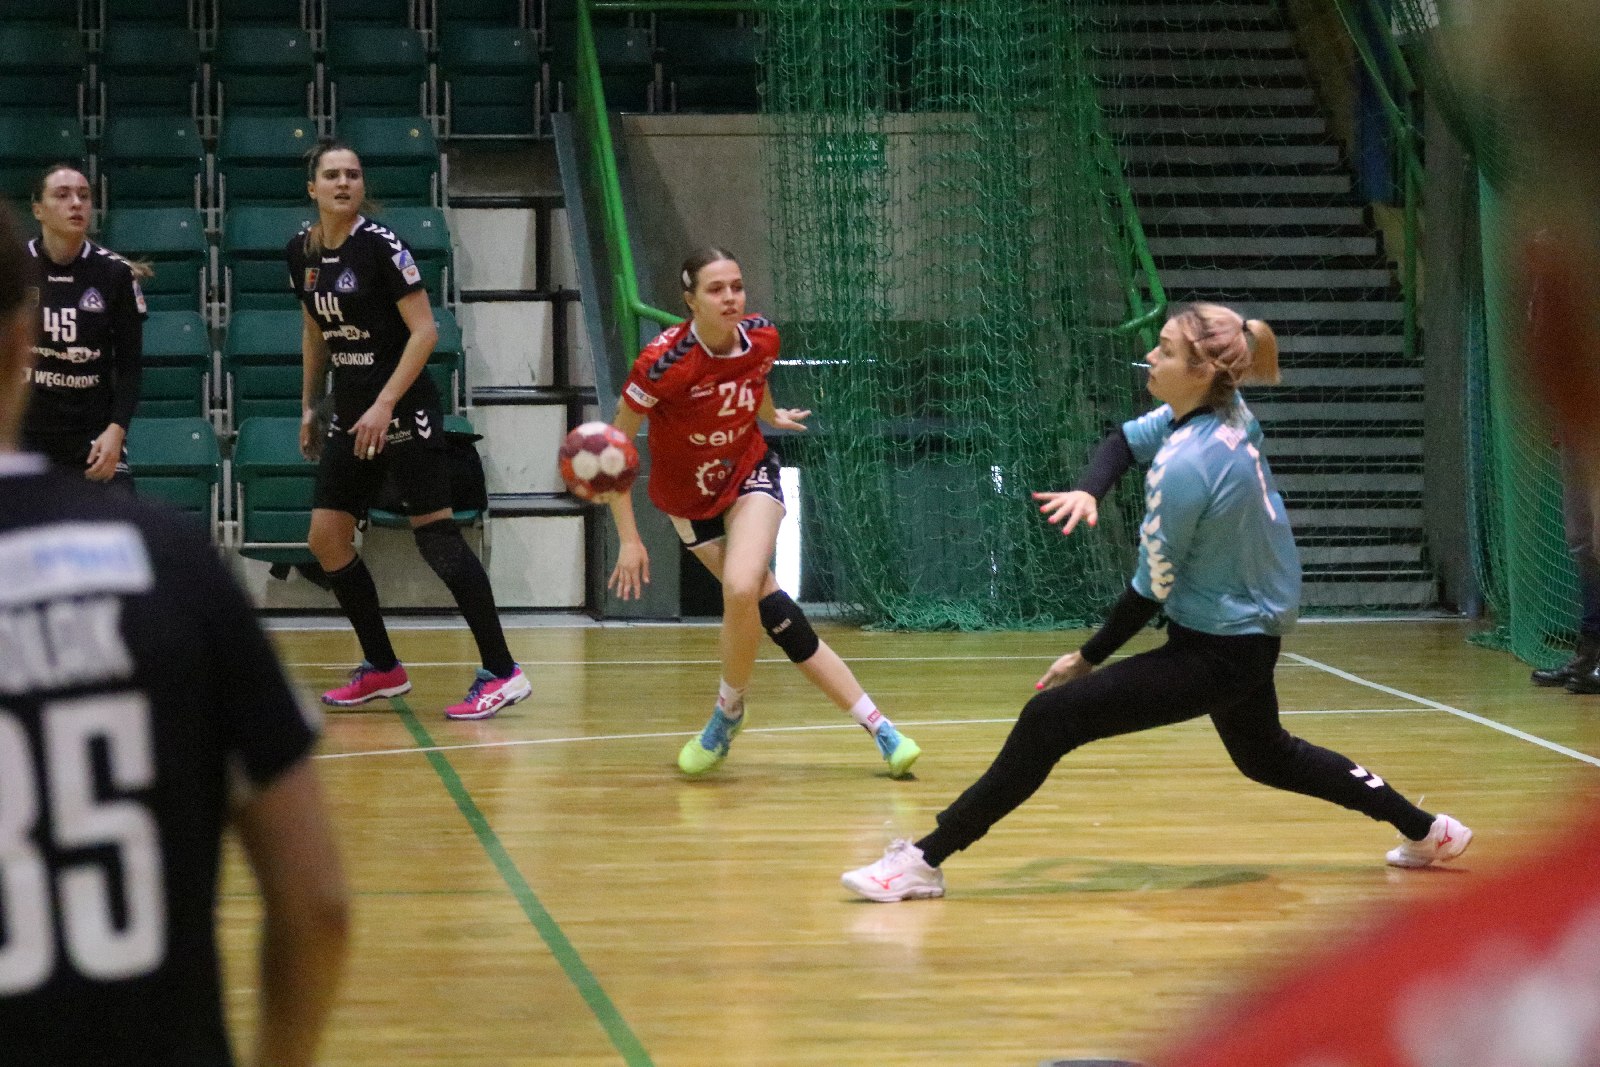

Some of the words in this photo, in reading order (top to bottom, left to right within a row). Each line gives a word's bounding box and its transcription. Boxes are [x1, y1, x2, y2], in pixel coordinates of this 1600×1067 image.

[314, 291, 344, 322] 44
[43, 307, 77, 342] 45
[717, 379, 756, 416] 24
